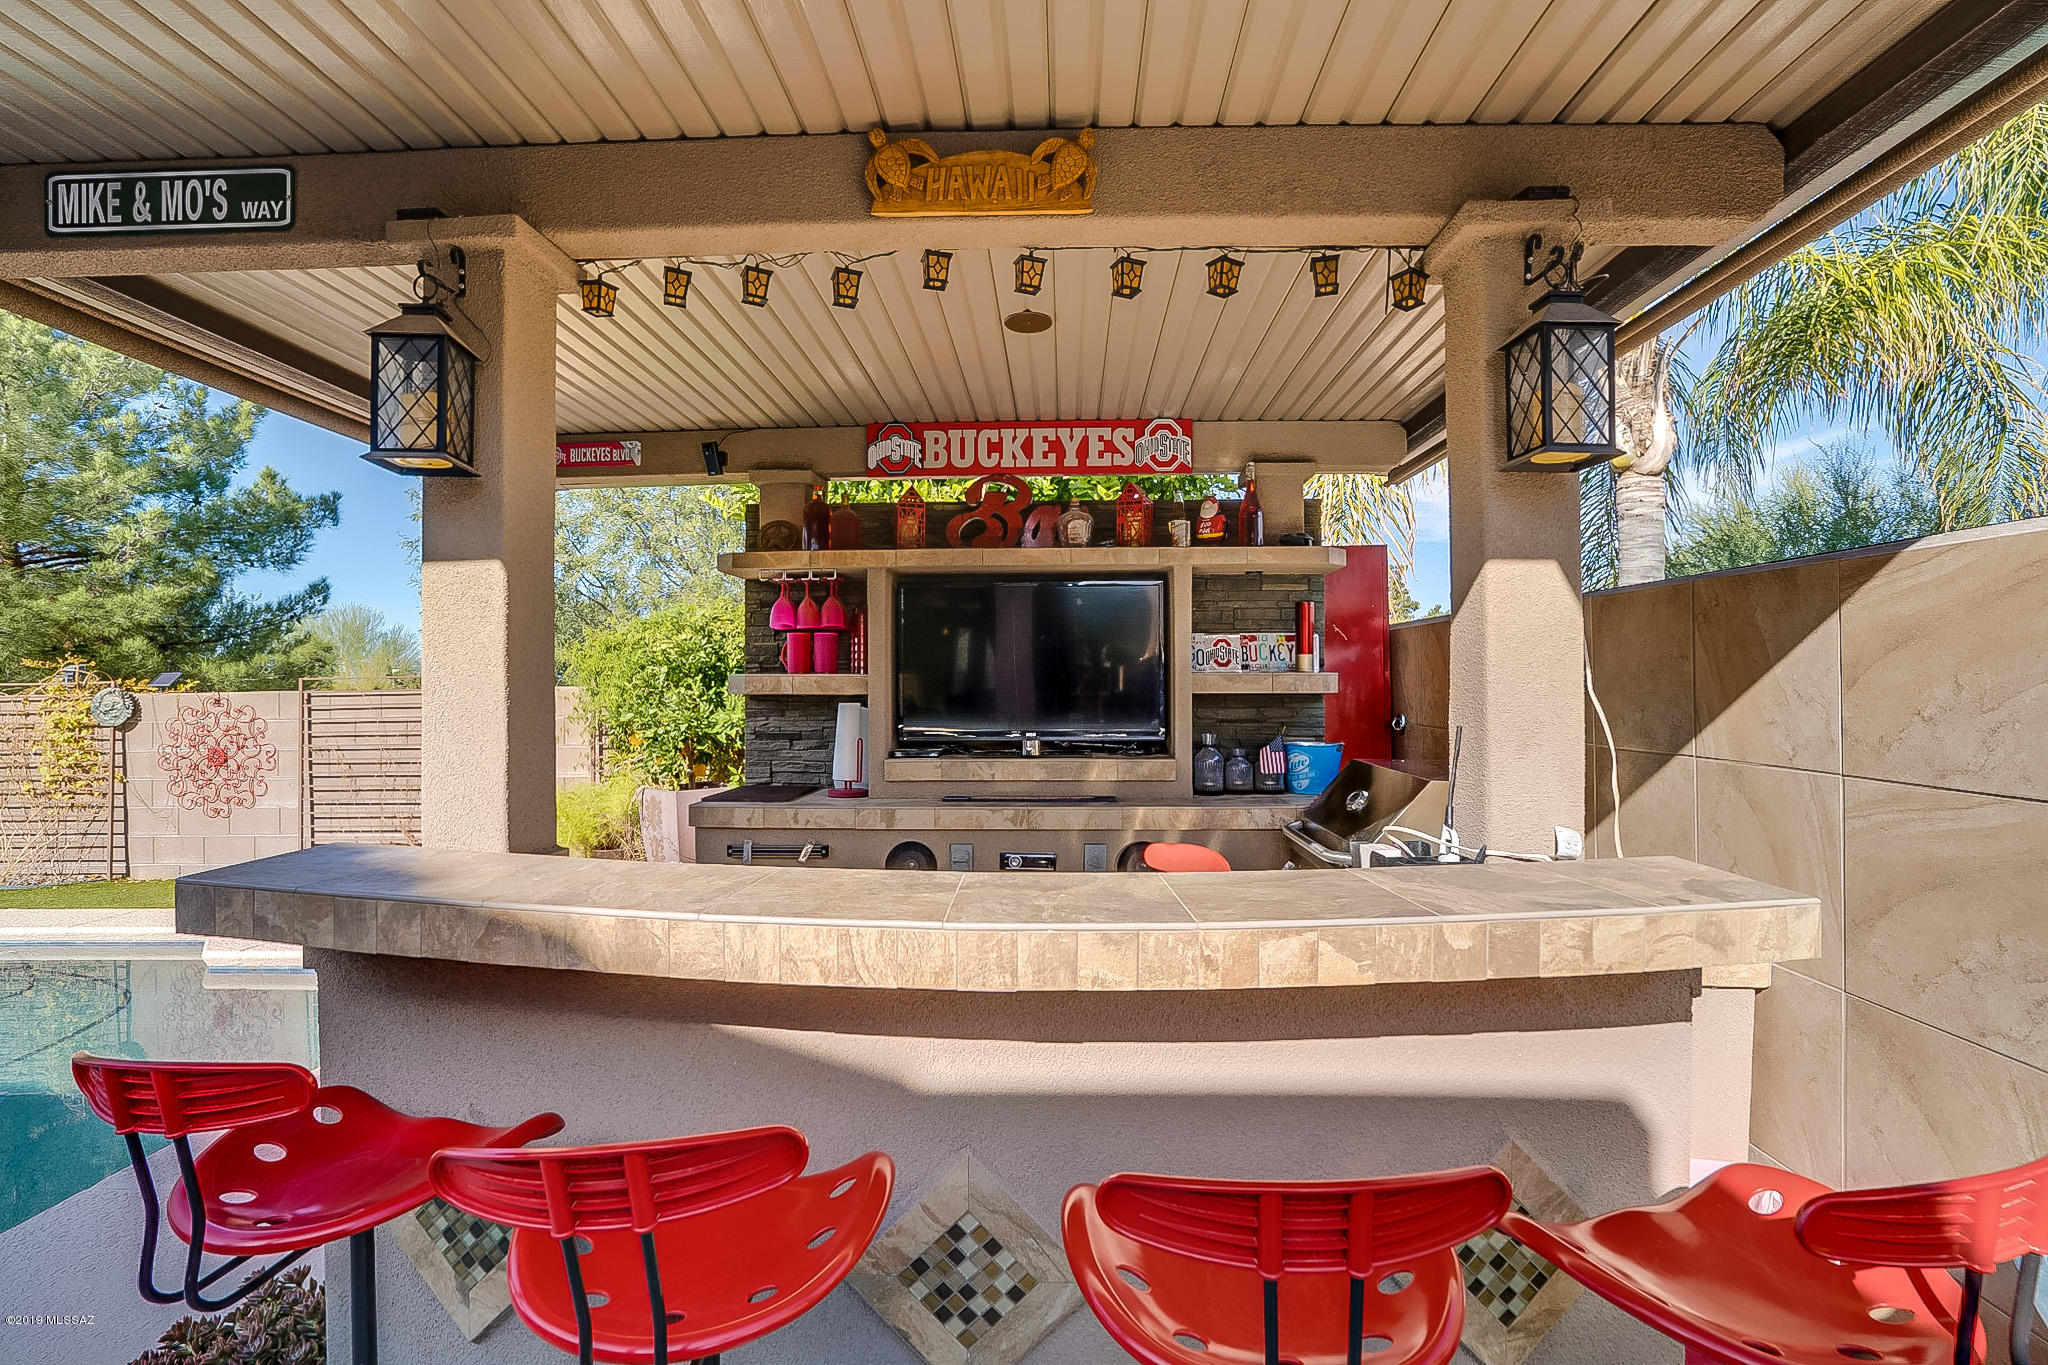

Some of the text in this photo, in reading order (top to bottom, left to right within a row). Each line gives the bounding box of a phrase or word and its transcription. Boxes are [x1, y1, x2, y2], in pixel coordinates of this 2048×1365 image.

[58, 178, 283, 224] MIKE & MO'S WAY
[924, 165, 1037, 201] HAWAII
[570, 447, 610, 463] BUCKEYES
[923, 427, 1135, 469] BUCKEYES
